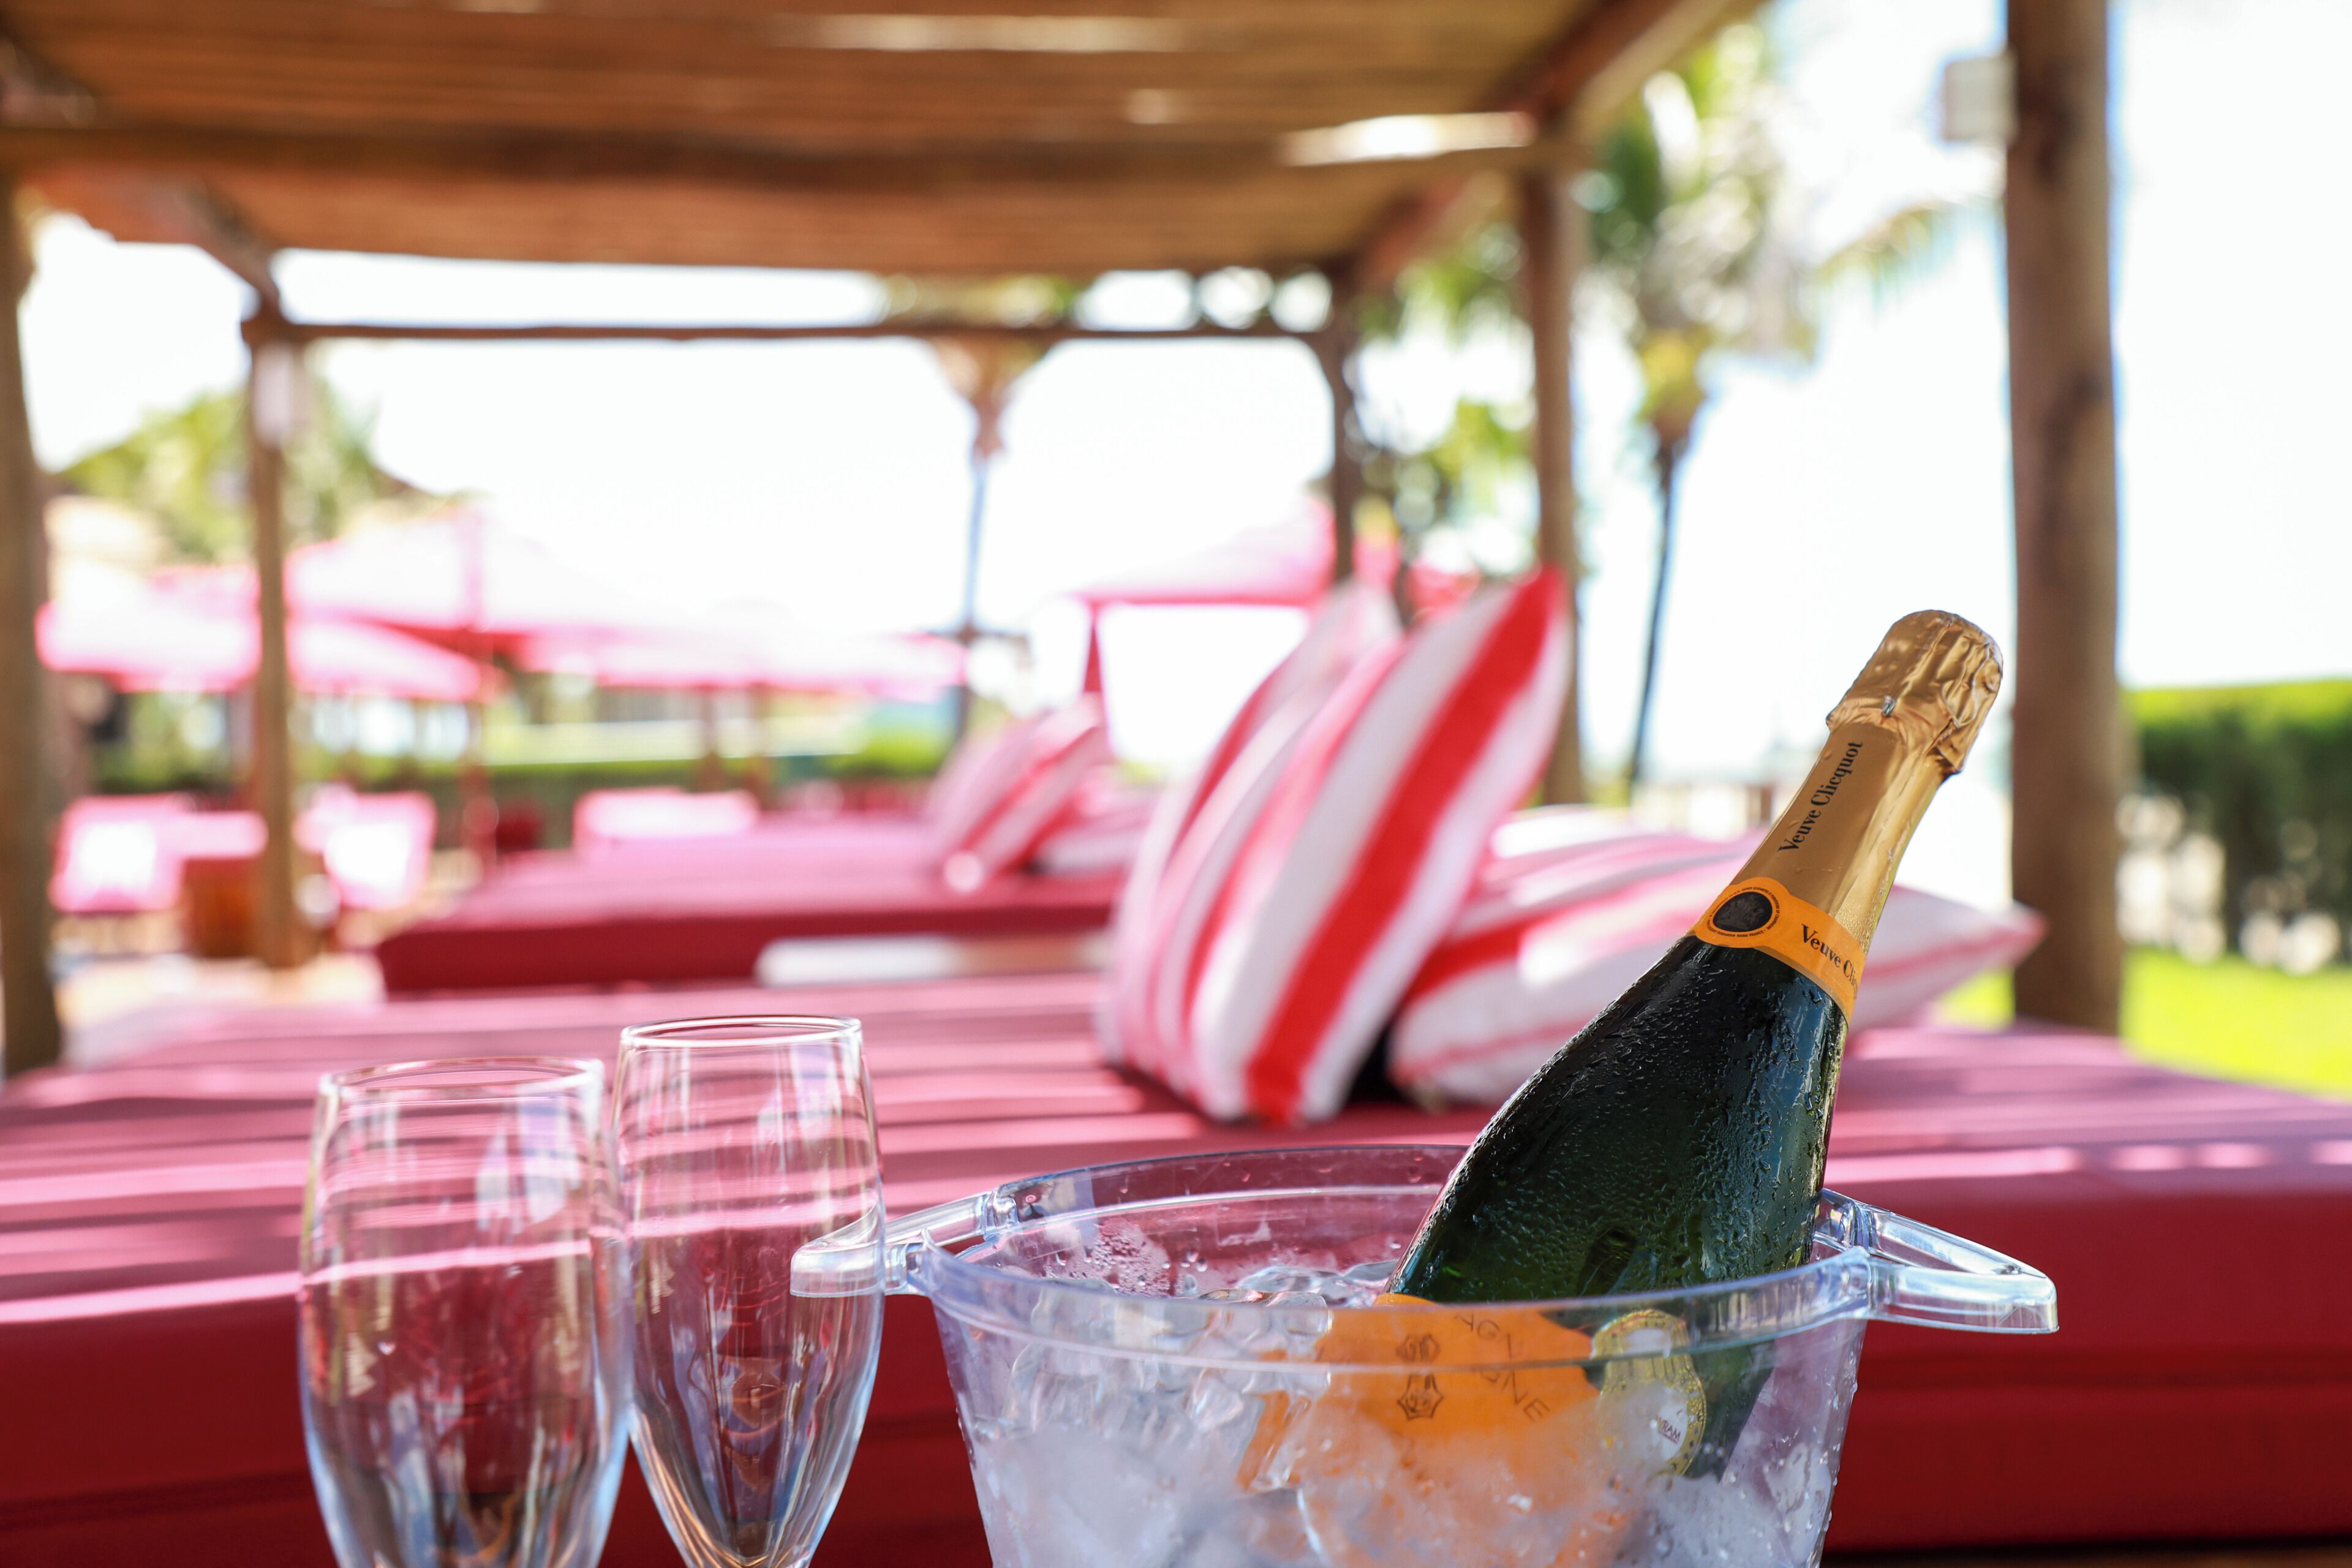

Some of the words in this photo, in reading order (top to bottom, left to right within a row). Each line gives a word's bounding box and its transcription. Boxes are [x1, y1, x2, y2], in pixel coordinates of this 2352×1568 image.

[1777, 809, 1822, 852] Veuve
[1811, 741, 1863, 806] Clicquot
[1801, 924, 1841, 968] Veuve
